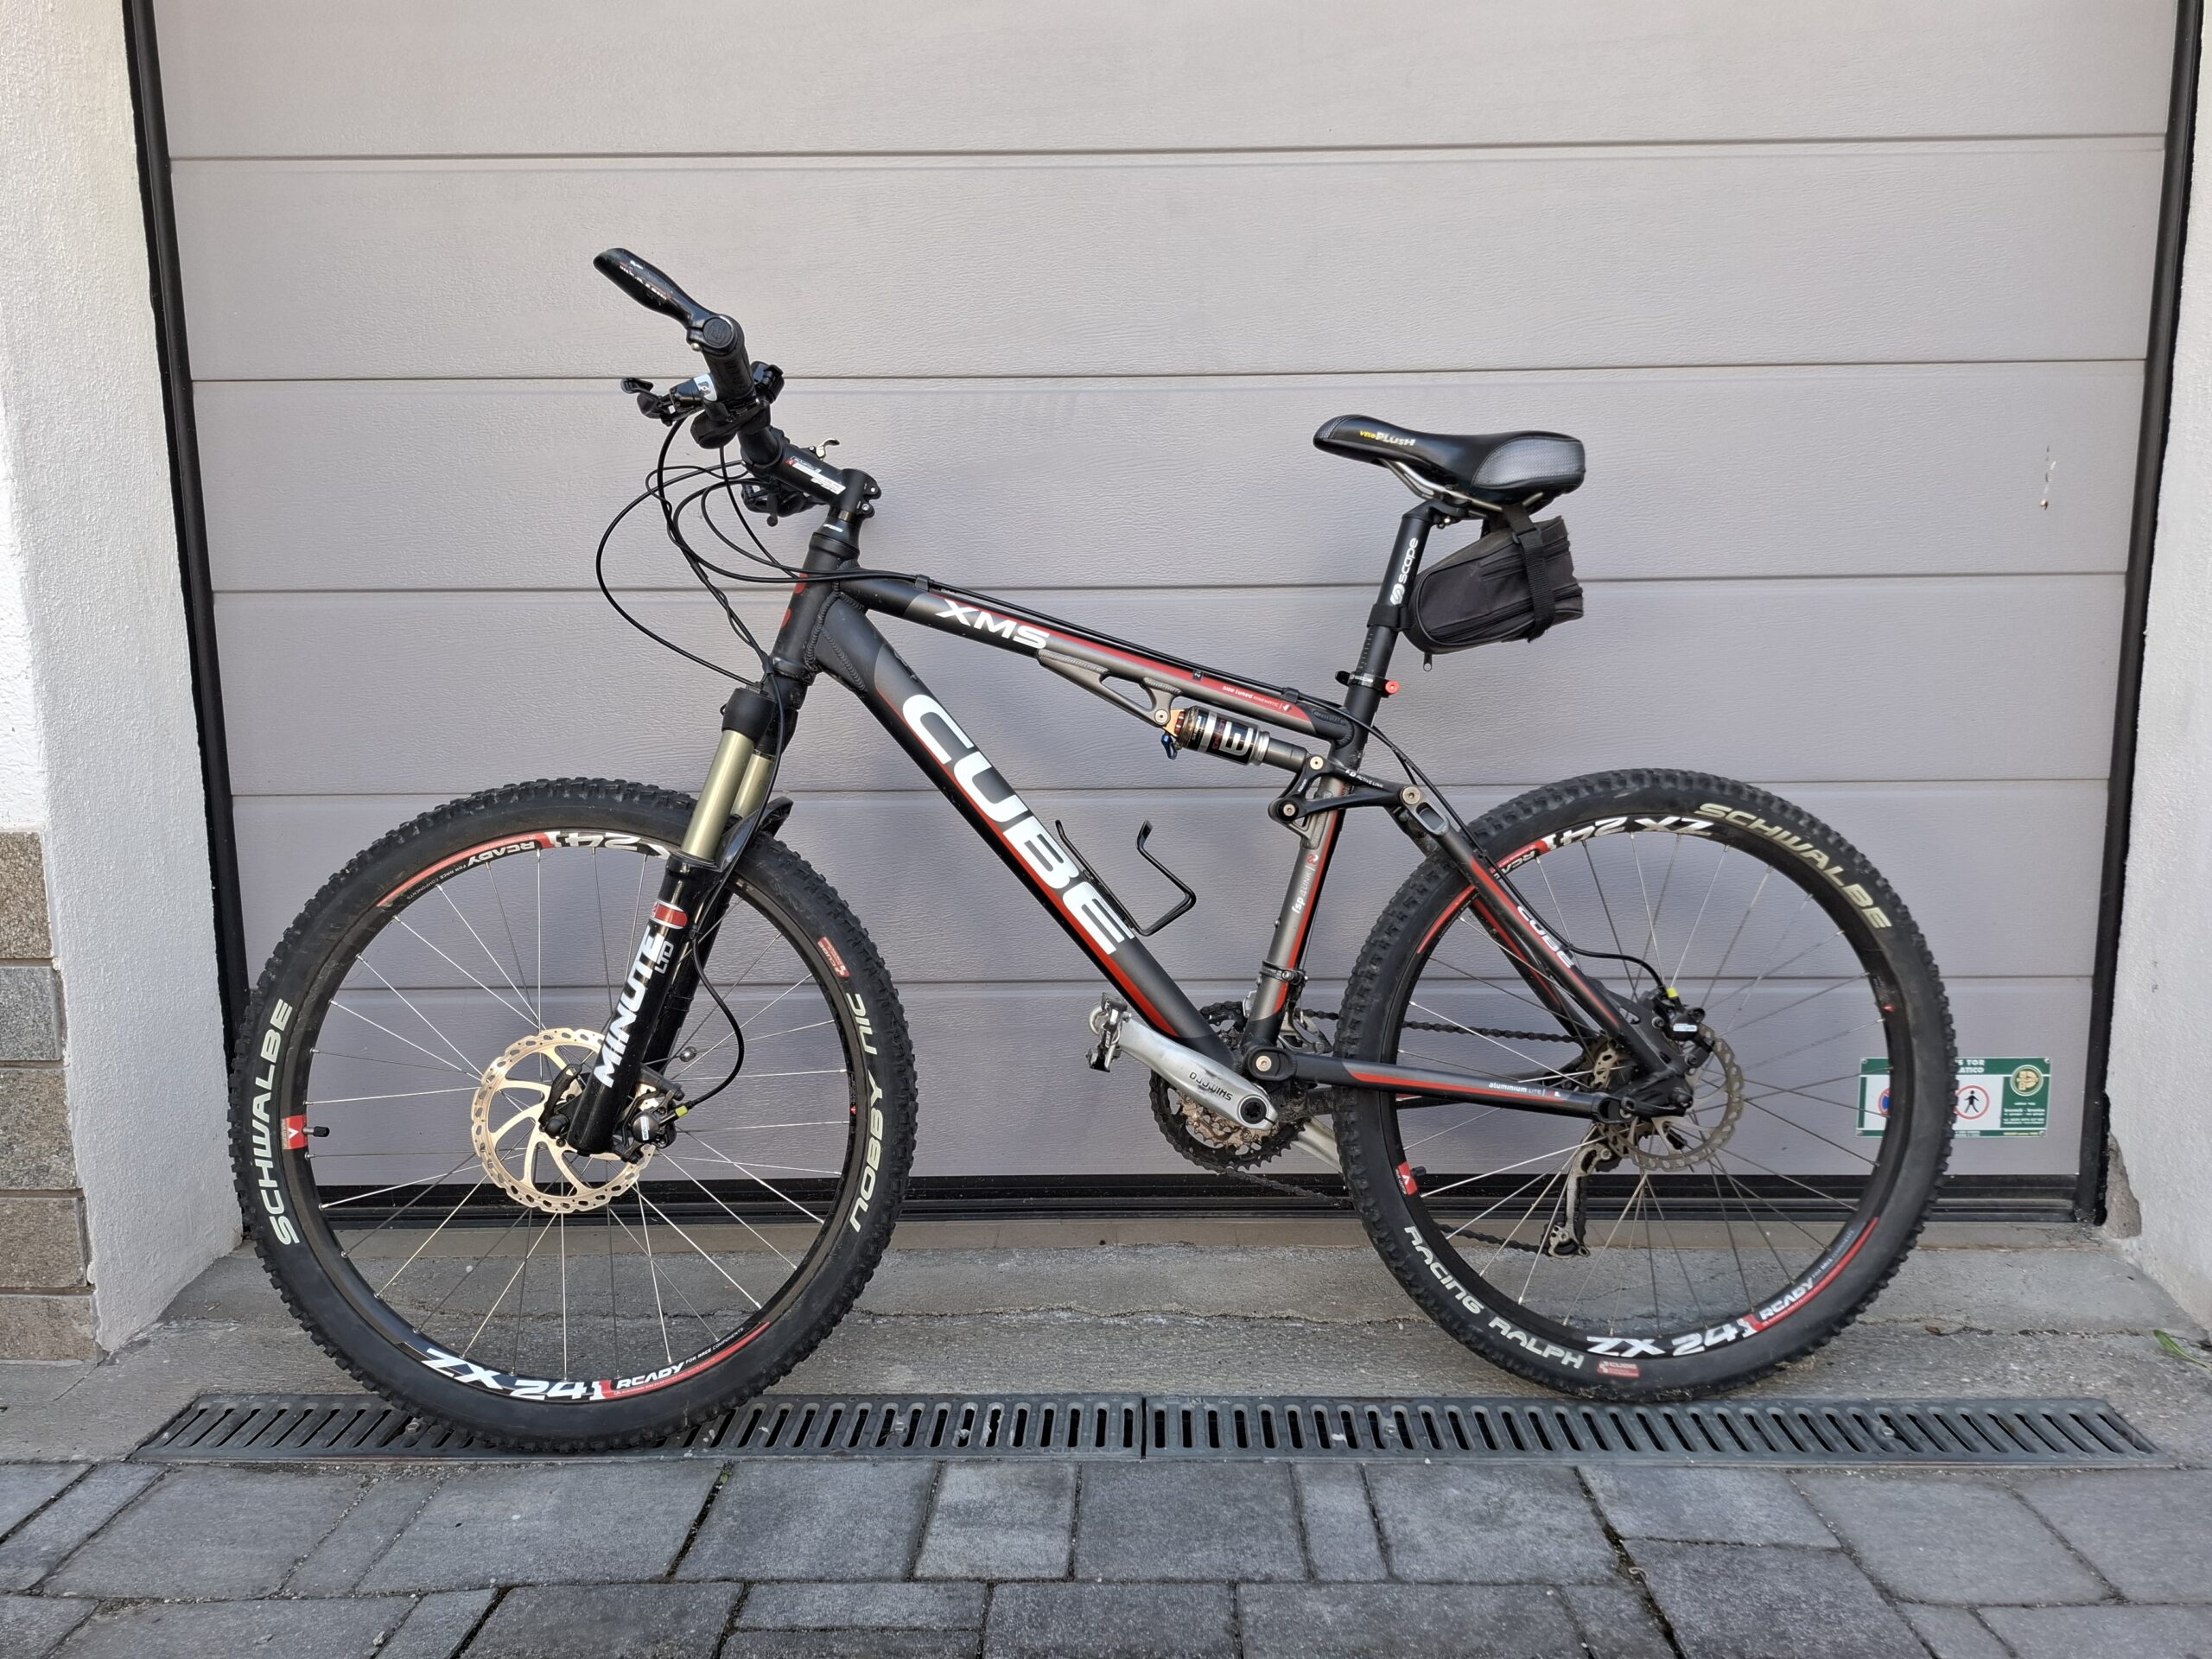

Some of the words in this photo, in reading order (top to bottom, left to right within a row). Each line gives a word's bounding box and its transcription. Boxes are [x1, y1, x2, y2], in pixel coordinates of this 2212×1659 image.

[1398, 537, 1419, 584] scape
[935, 598, 1051, 651] XMS
[1223, 684, 1236, 694] size
[1236, 690, 1253, 699] tuned
[548, 830, 641, 851] 241
[901, 693, 1135, 956] CUBE
[1541, 817, 1628, 851] 241
[1634, 816, 1715, 837] ZX
[467, 841, 536, 868] READY
[1494, 850, 1536, 880] REA
[1694, 802, 1893, 929] SCHWALBE
[655, 940, 674, 975] LTD
[1517, 905, 1574, 969] CUBE
[594, 925, 664, 1088] MINUTE
[846, 991, 878, 1056] NIC
[1488, 1082, 1527, 1093] aluminium
[251, 999, 300, 1245] SCHWALBE
[849, 1070, 884, 1232] NOBBY
[1403, 1225, 1484, 1314] RACING
[1488, 1316, 1584, 1369] RALPH
[1586, 1335, 1666, 1358] ZX
[1672, 1318, 1760, 1357] 241
[1759, 1277, 1815, 1320] READY
[421, 1348, 503, 1390] ZX
[510, 1379, 607, 1402] 241
[616, 1361, 685, 1389] READY
[685, 1355, 696, 1364] FOR
[697, 1348, 712, 1359] RACE
[712, 1327, 745, 1351] COMPONENTS
